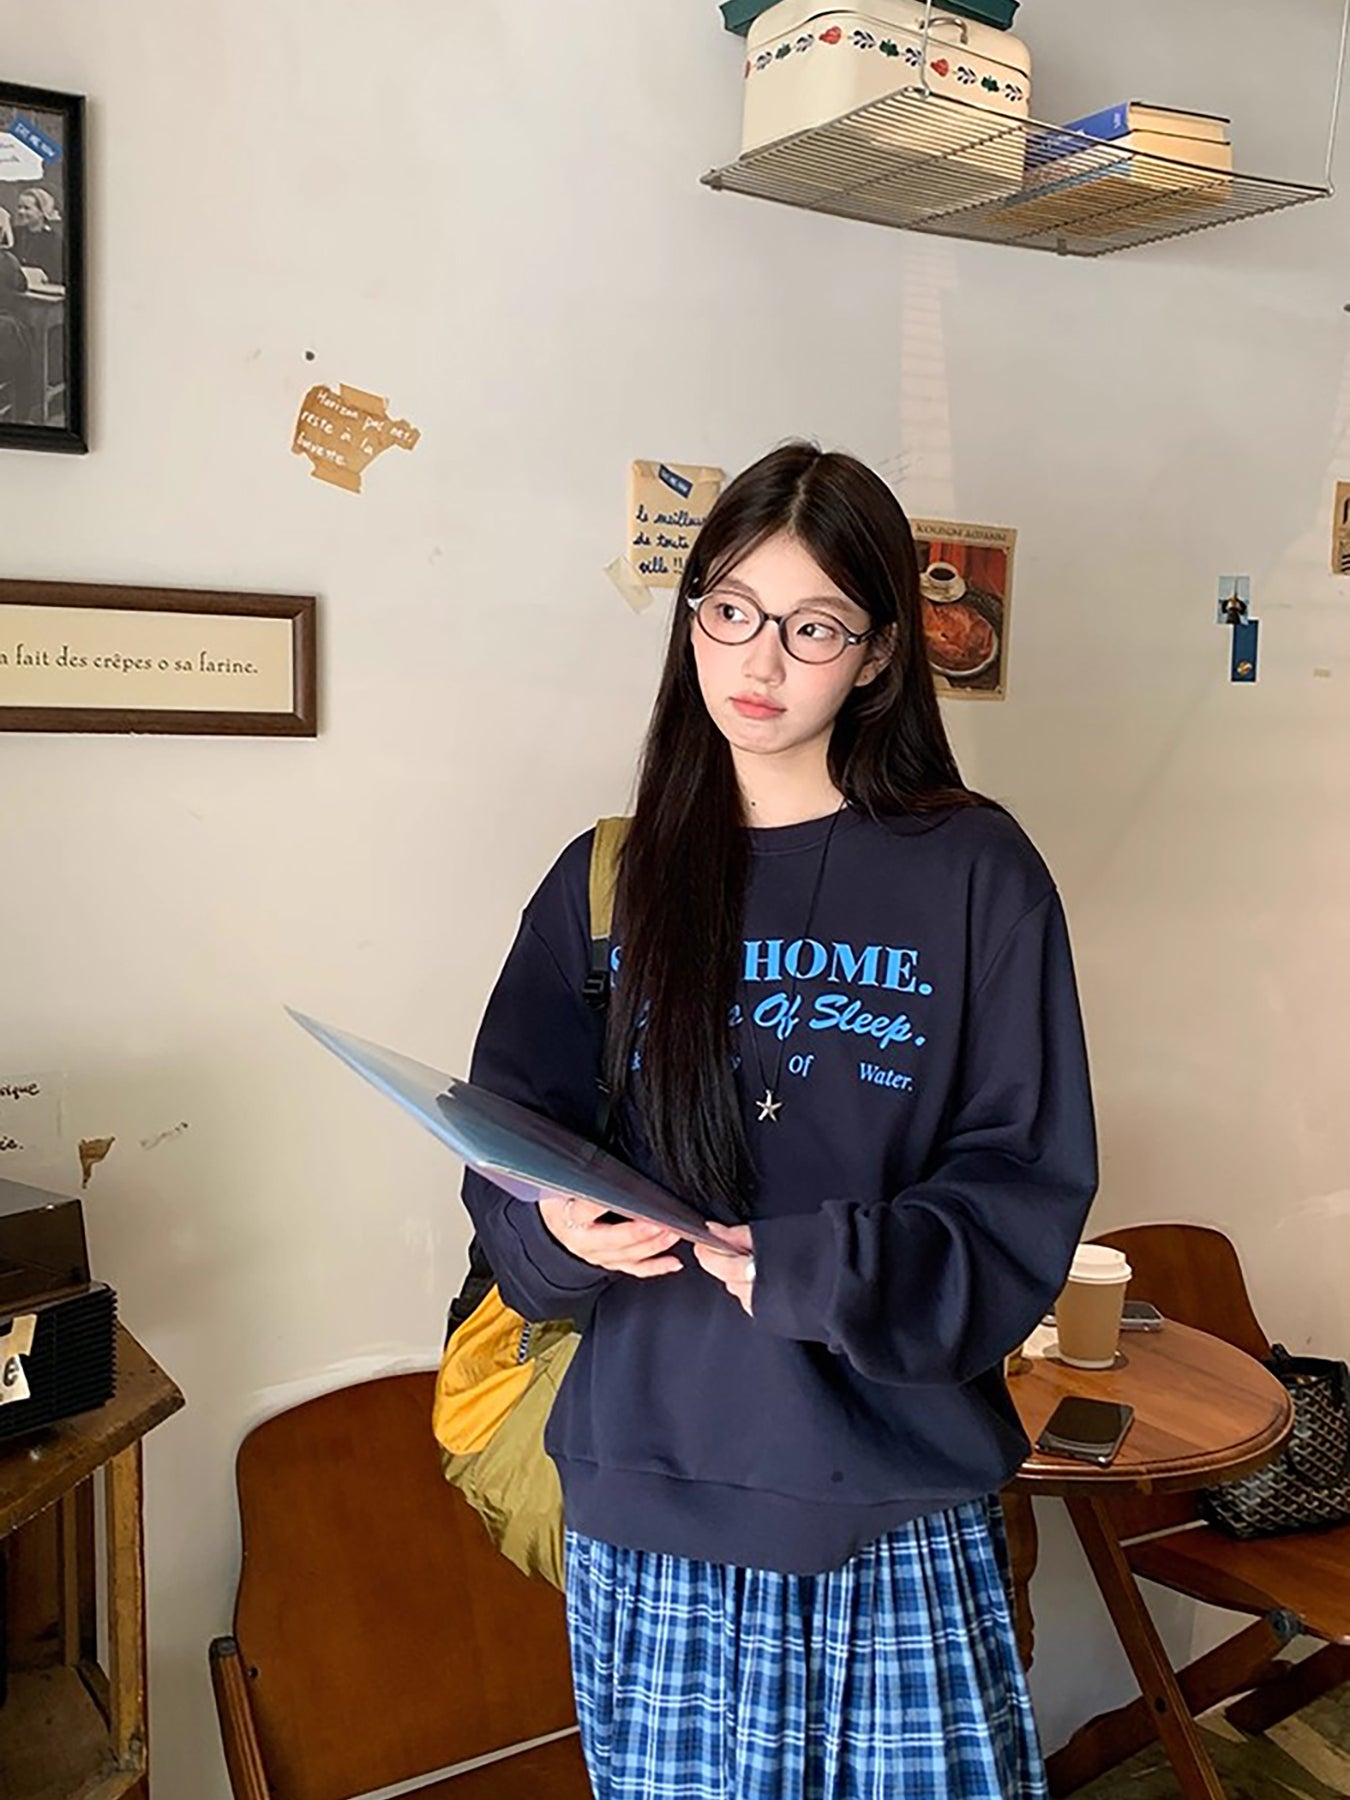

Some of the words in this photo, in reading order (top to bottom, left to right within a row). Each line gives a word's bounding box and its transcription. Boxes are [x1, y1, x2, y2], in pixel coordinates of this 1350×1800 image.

[301, 410, 334, 434] reste
[360, 437, 374, 456] la
[633, 531, 651, 546] de
[16, 643, 50, 666] fait
[55, 645, 88, 667] des
[93, 650, 152, 673] crêpes
[157, 658, 169, 671] o
[174, 658, 194, 672] sa
[199, 650, 259, 674] farine.
[743, 938, 934, 996] HOME.
[752, 992, 801, 1041] Of
[808, 993, 927, 1050] Sleep.
[858, 1061, 914, 1092] Water.
